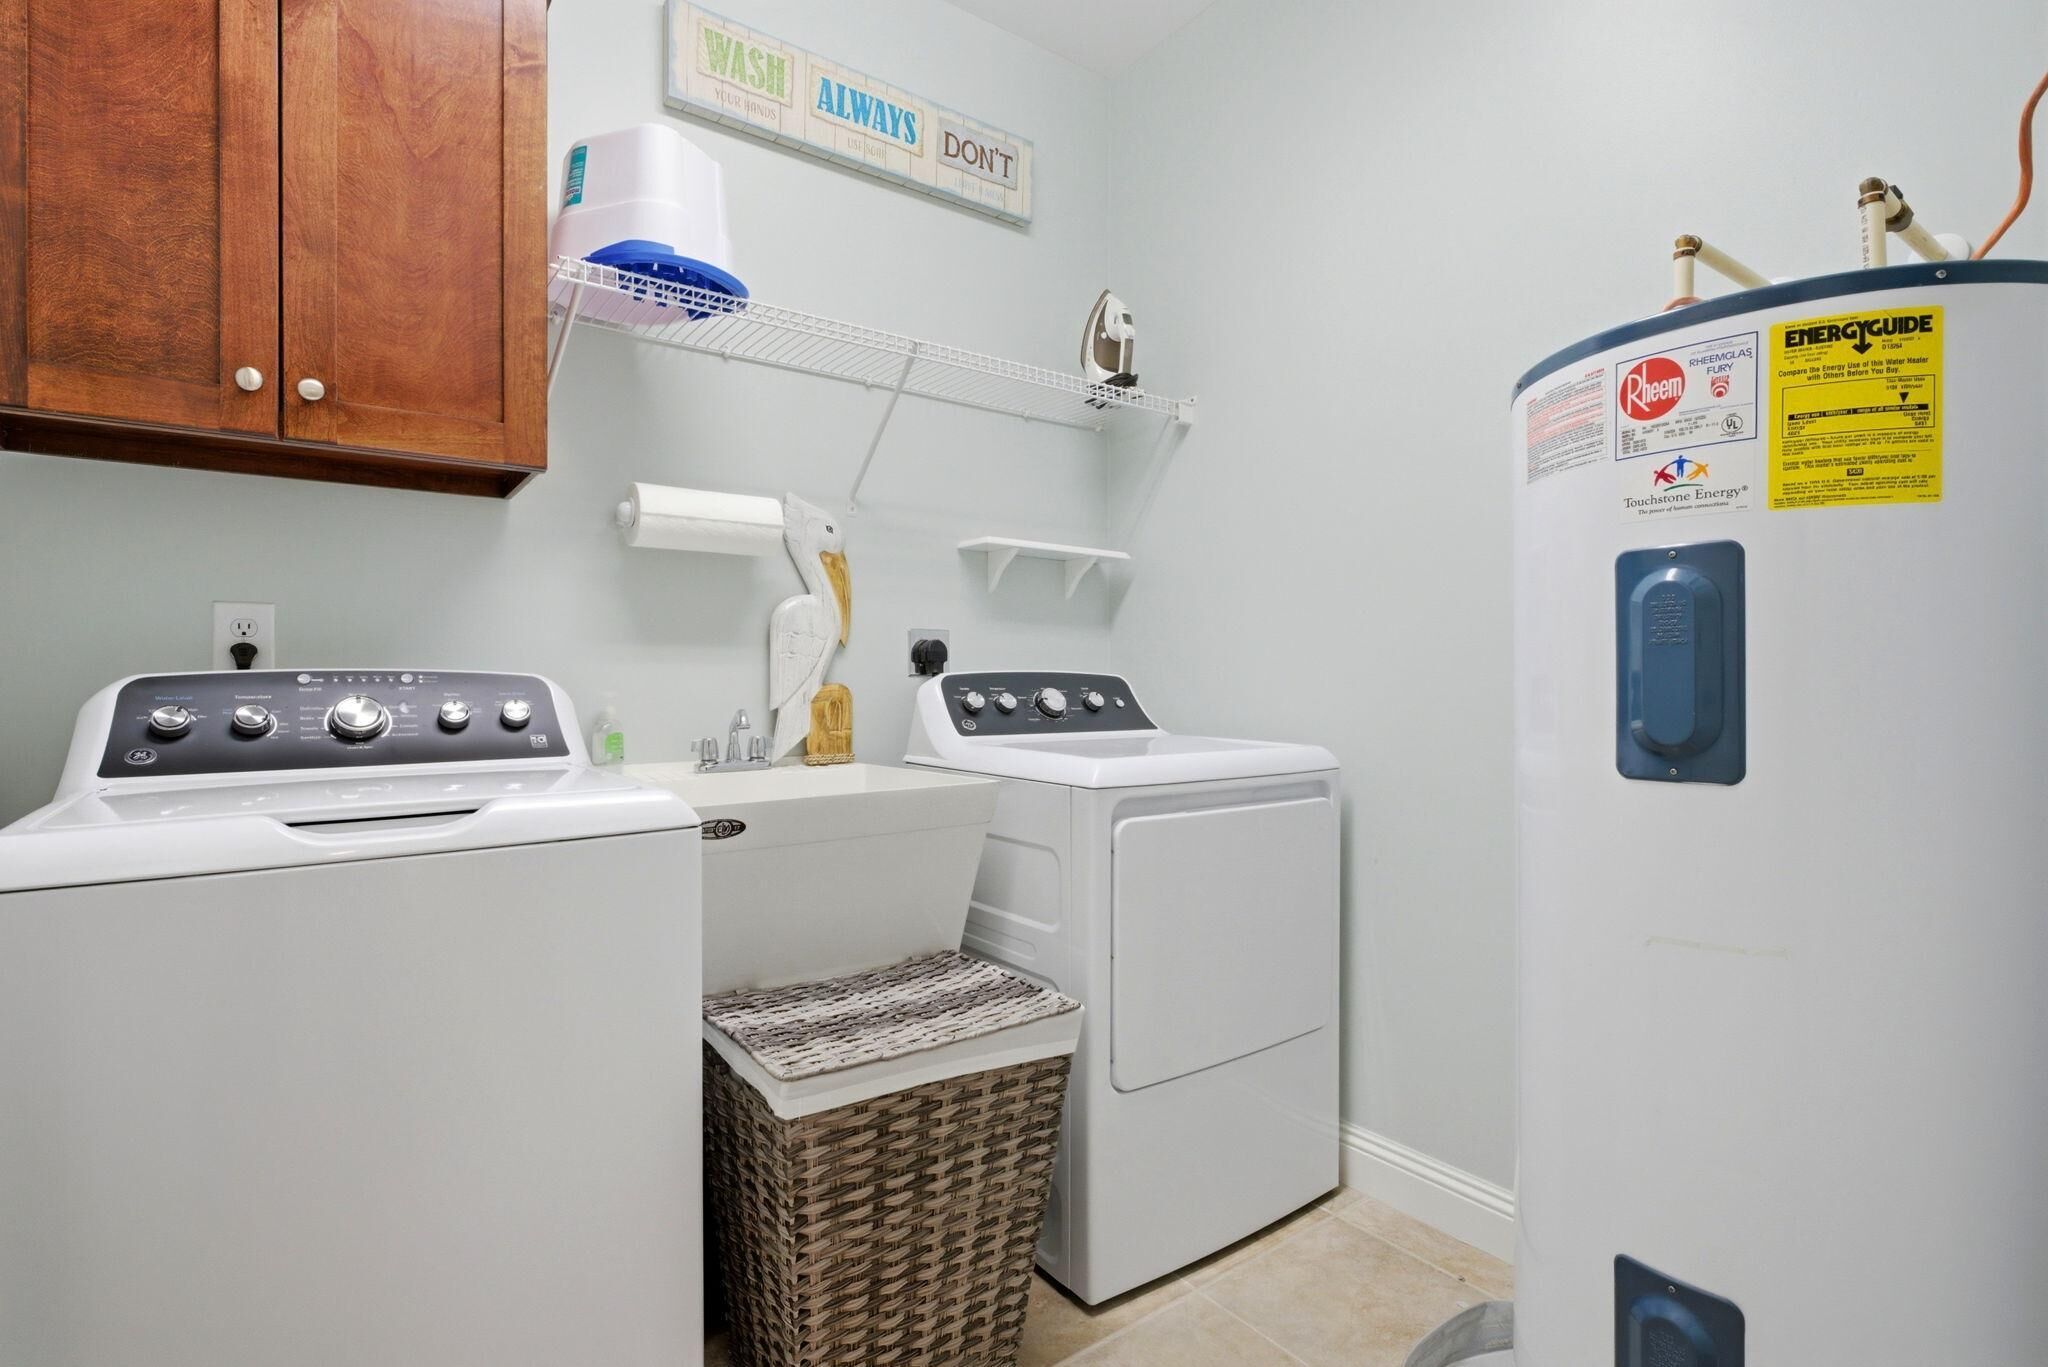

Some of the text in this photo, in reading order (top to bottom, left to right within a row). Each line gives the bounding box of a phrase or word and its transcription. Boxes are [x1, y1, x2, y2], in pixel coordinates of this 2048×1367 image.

[703, 27, 785, 99] WASH
[713, 87, 777, 121] YOUR HANDS
[817, 76, 917, 145] ALWAYS
[943, 130, 1014, 179] DON'T
[1706, 362, 1734, 375] FURY
[1822, 364, 1846, 372] Energy
[1847, 361, 1860, 369] Use
[1885, 358, 1905, 366] Water
[1823, 371, 1845, 379] Others
[1846, 369, 1869, 377] Before
[1871, 367, 1884, 375] You
[1627, 362, 1683, 415] Rheem
[1623, 493, 1691, 508] Touchstone
[1649, 507, 1665, 515] power
